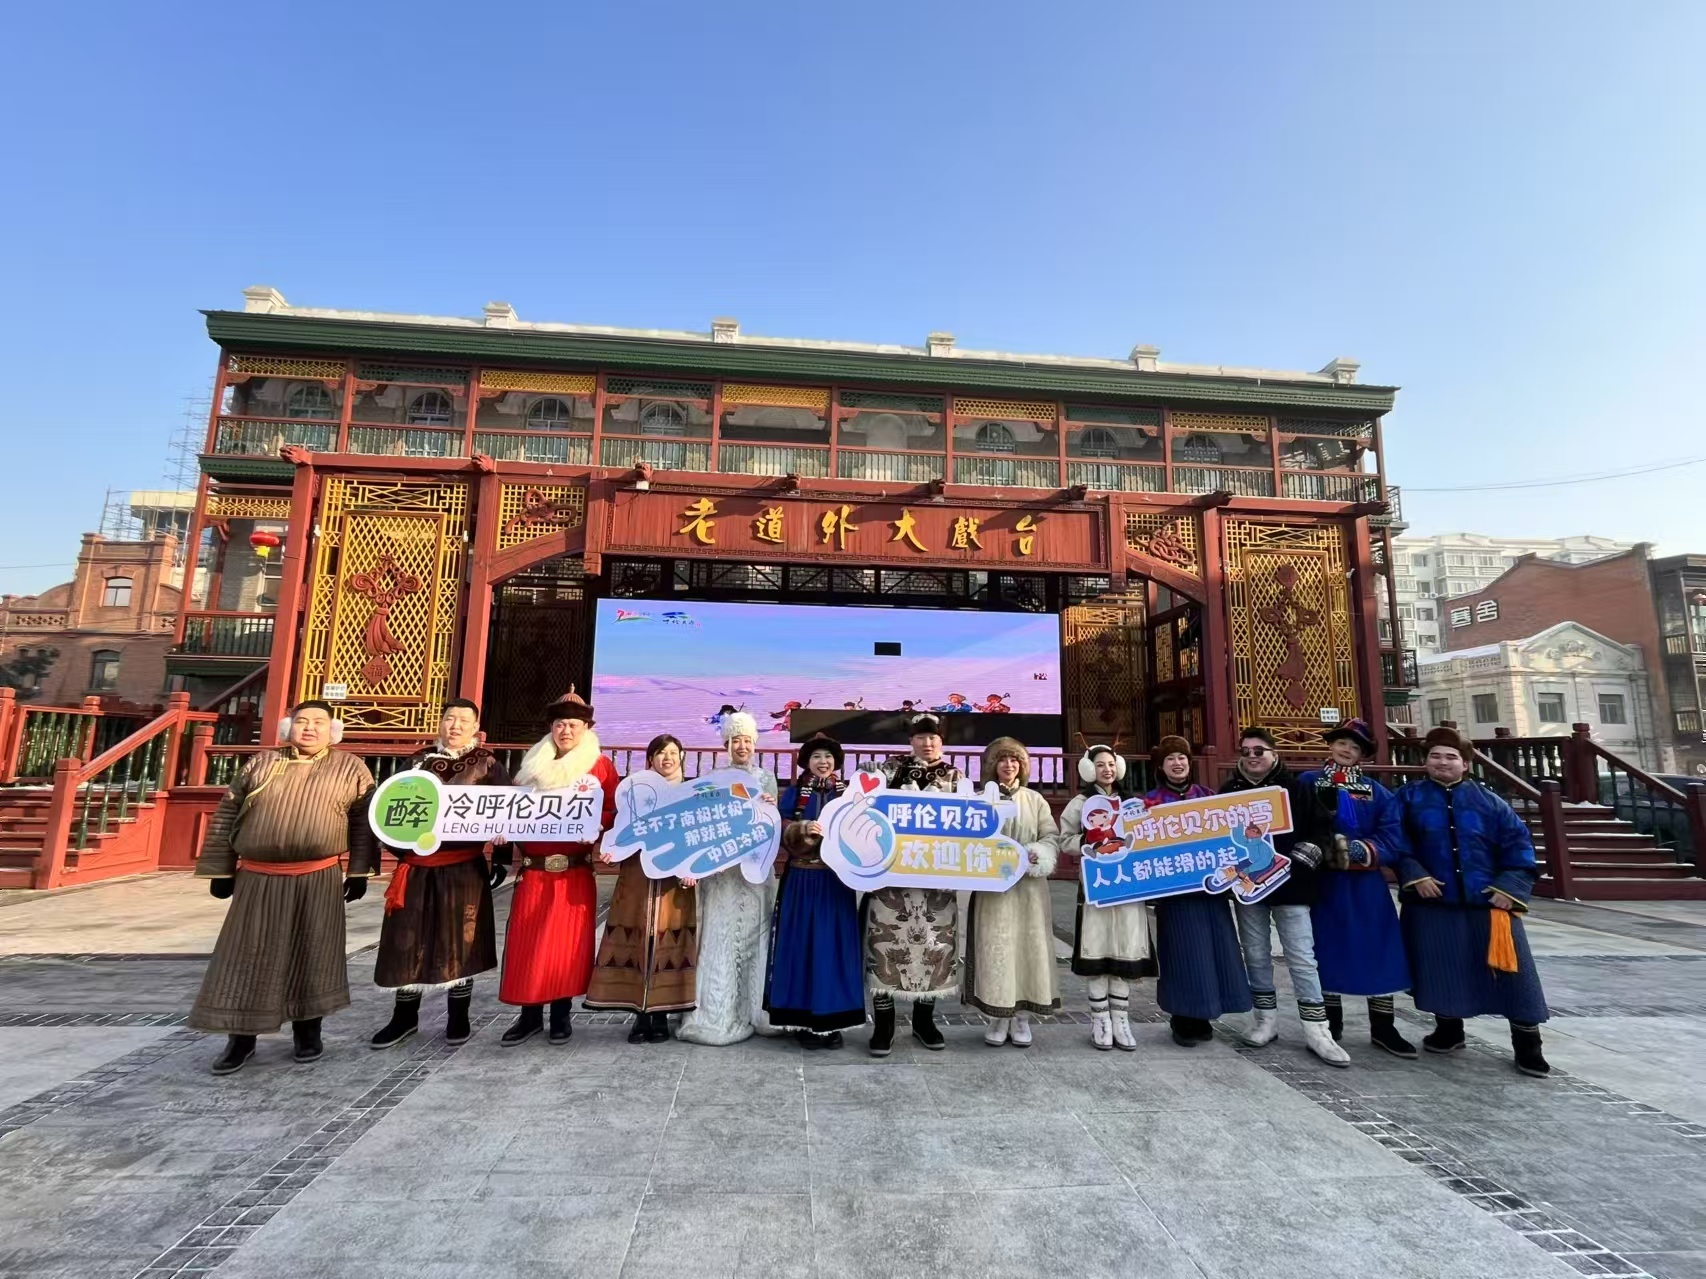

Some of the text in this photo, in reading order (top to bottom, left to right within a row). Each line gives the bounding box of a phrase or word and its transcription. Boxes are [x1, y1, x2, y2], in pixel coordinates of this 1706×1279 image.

[384, 795, 433, 828] 醉
[443, 792, 595, 820] 冷呼伦贝尔
[632, 800, 744, 837] 去不了南极北极
[887, 803, 988, 832] 呼伦贝尔
[1133, 799, 1273, 842] 呼伦贝尔的雪
[442, 822, 585, 835] LENG HU LUN BEI ER
[684, 821, 732, 847] 那就来
[707, 825, 769, 864] 中国冷极
[901, 839, 993, 873] 欢迎你
[1092, 847, 1239, 888] 人人都能滑的起
